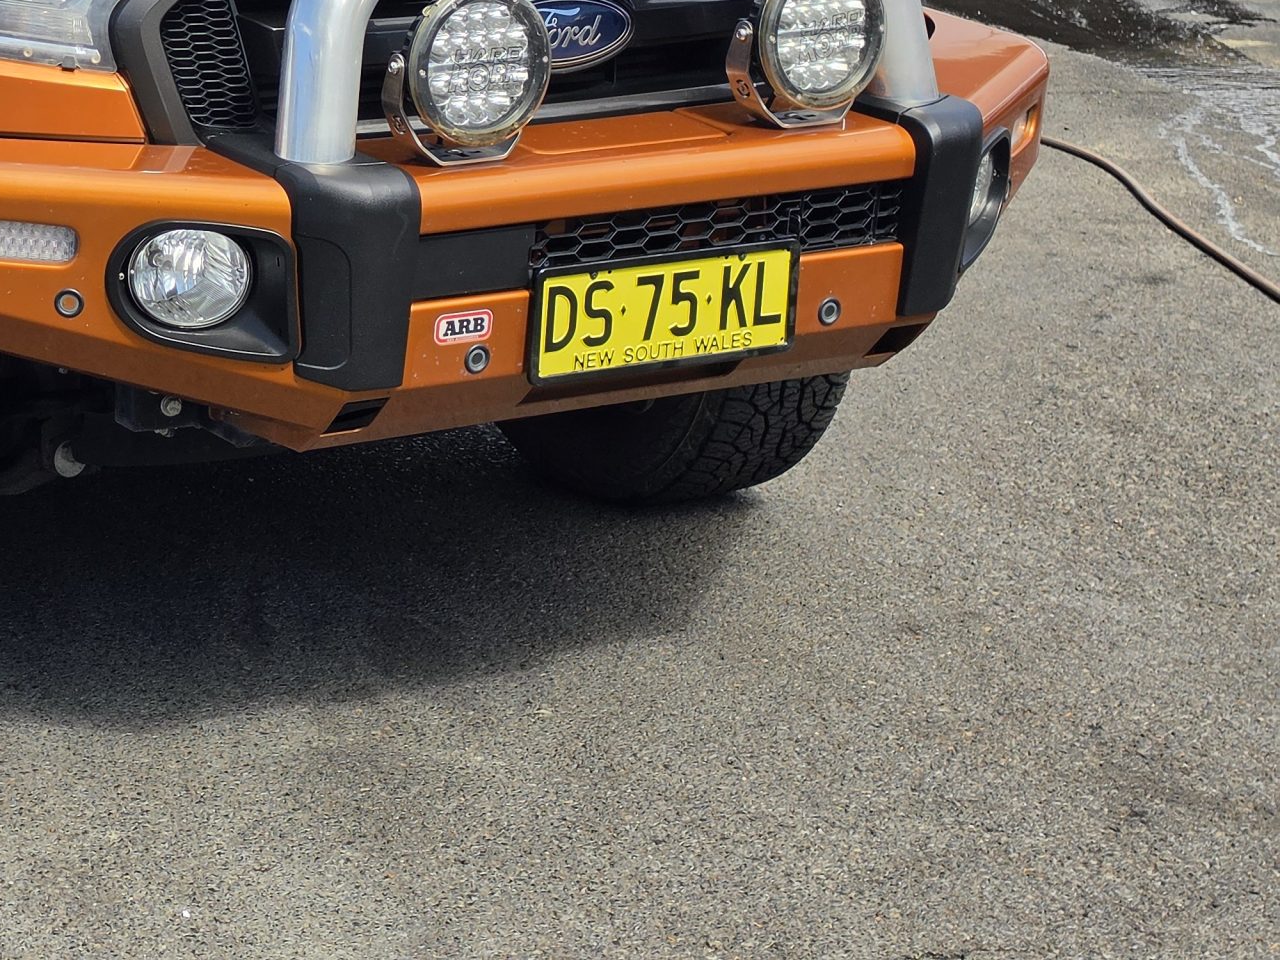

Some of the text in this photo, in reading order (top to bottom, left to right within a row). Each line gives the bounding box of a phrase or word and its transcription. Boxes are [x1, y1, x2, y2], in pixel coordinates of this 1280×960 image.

[537, 7, 602, 50] Ford
[442, 316, 485, 338] ARB
[573, 330, 753, 371] NEW SOUTH WALES
